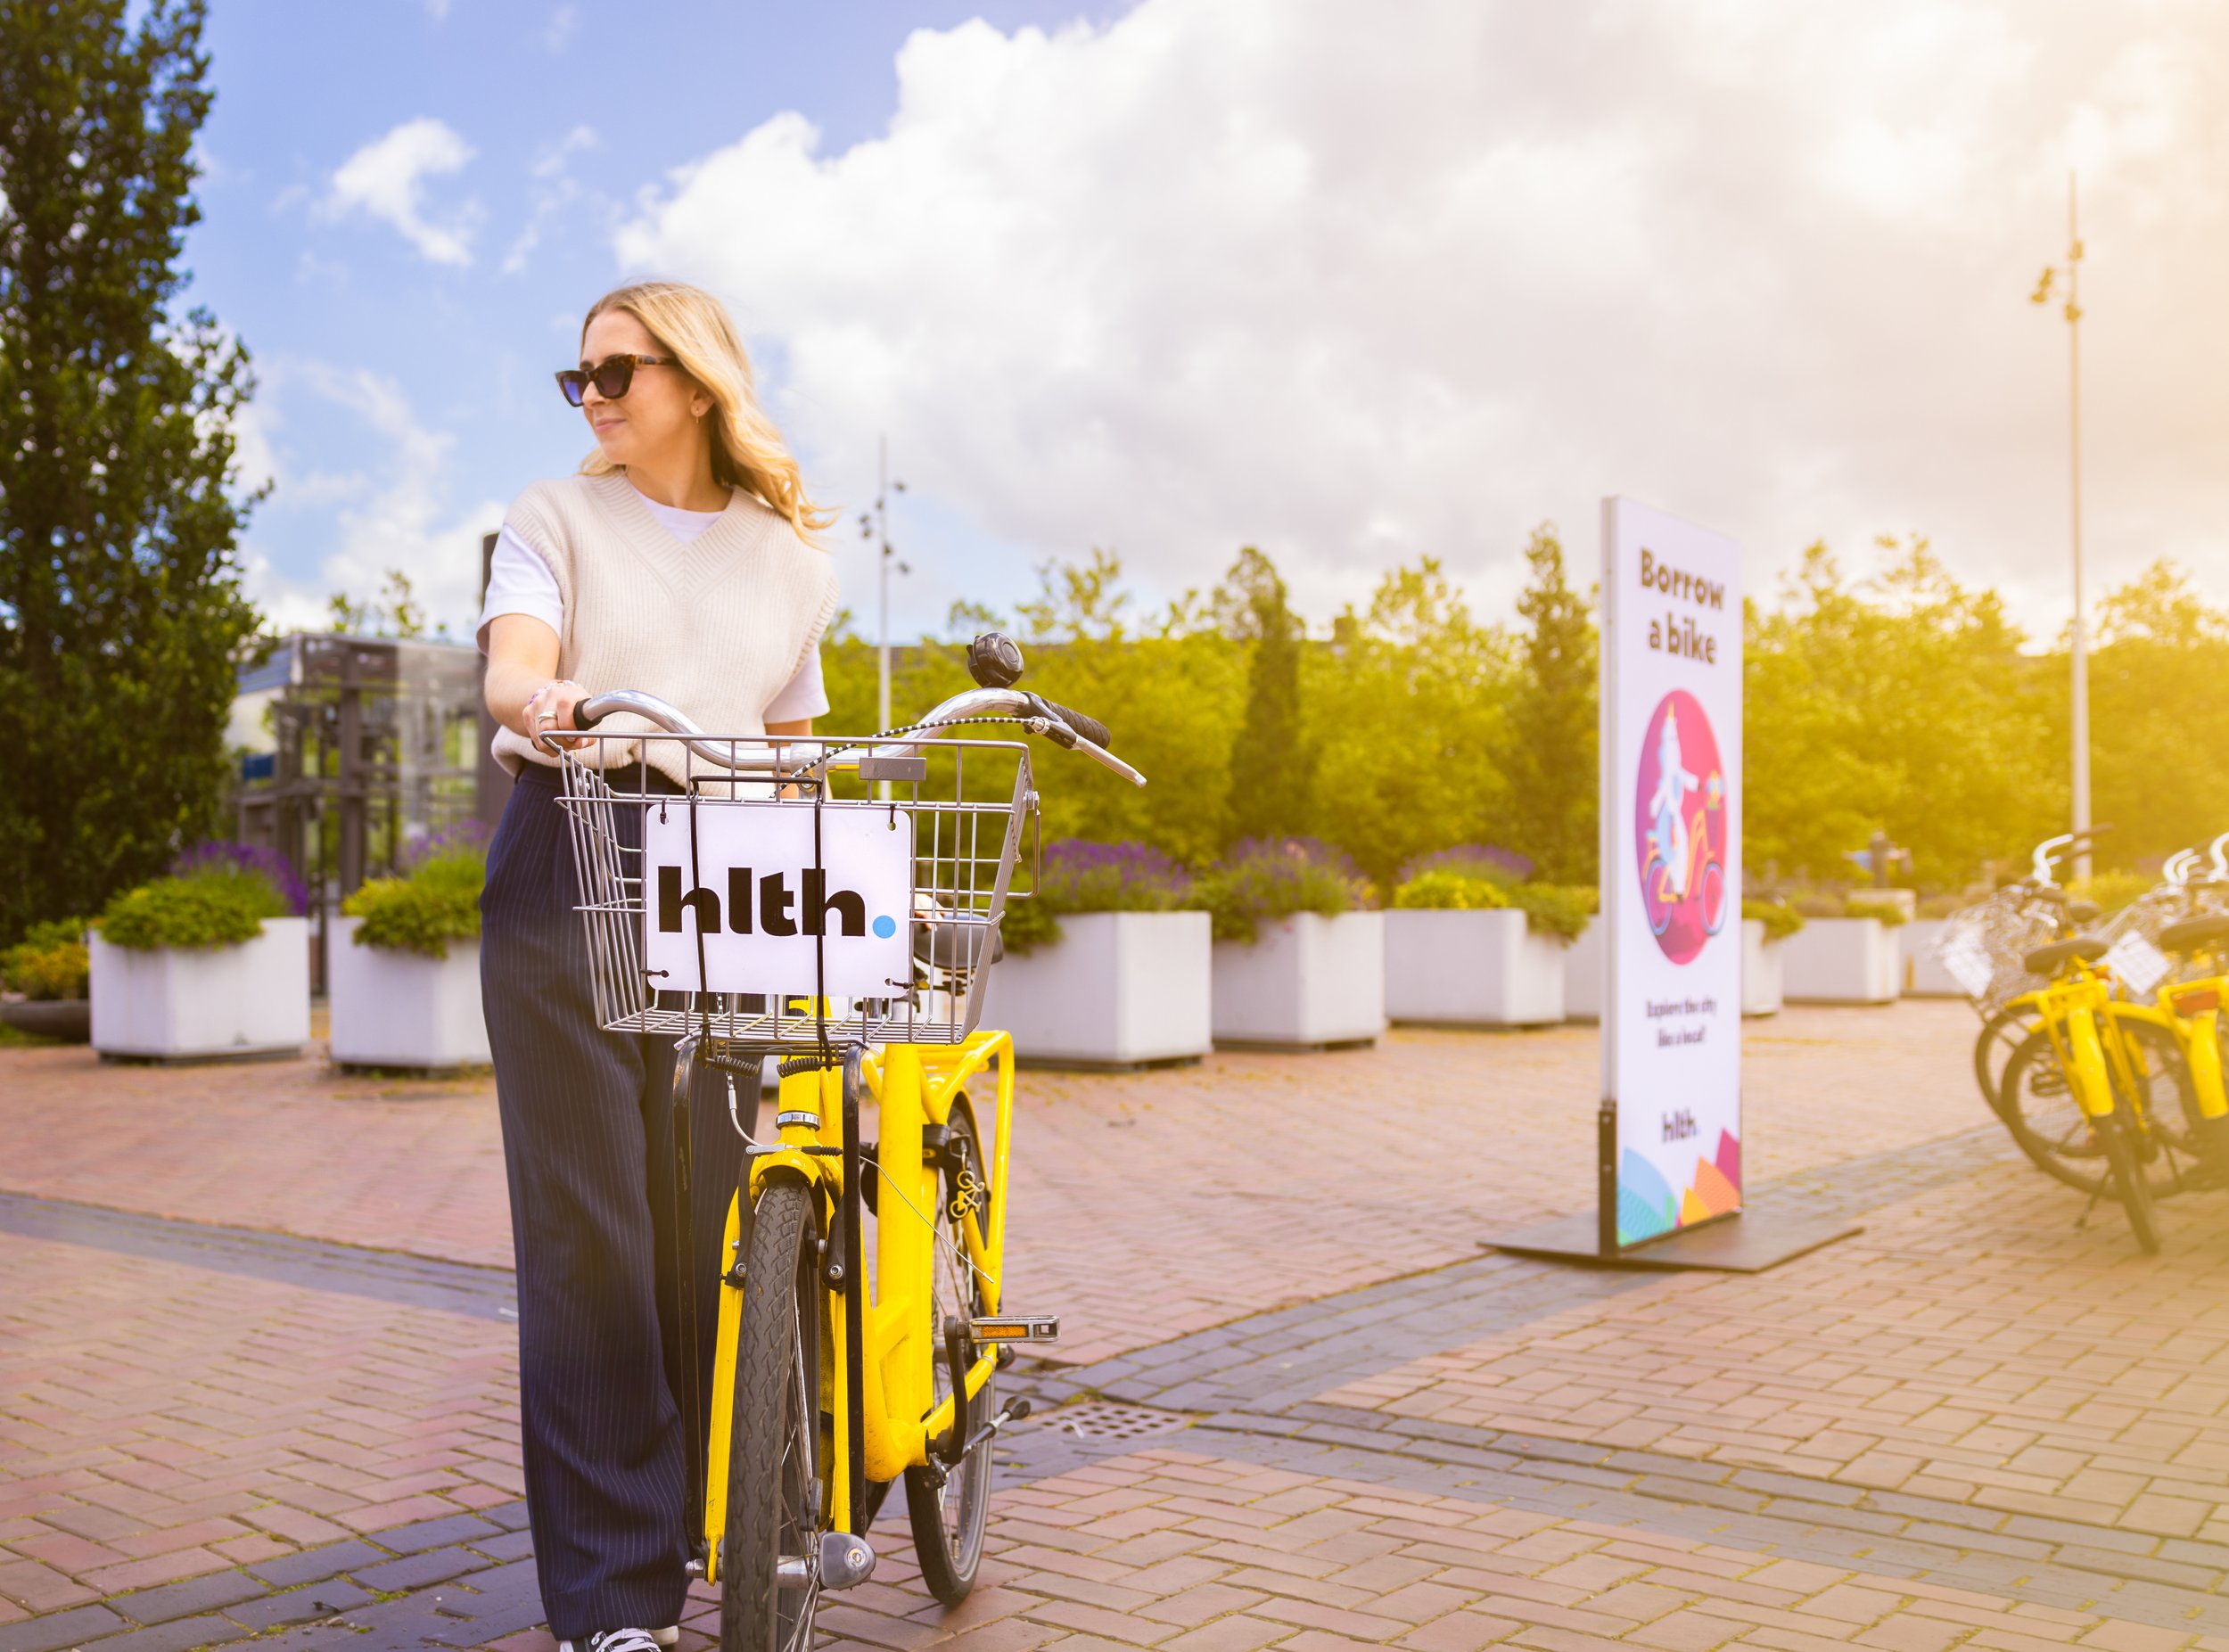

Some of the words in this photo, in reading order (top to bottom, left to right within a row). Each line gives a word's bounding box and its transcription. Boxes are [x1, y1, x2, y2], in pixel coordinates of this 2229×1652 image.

[1641, 547, 1725, 611] Borrow
[1649, 619, 1661, 650] a
[1667, 610, 1717, 665] bike
